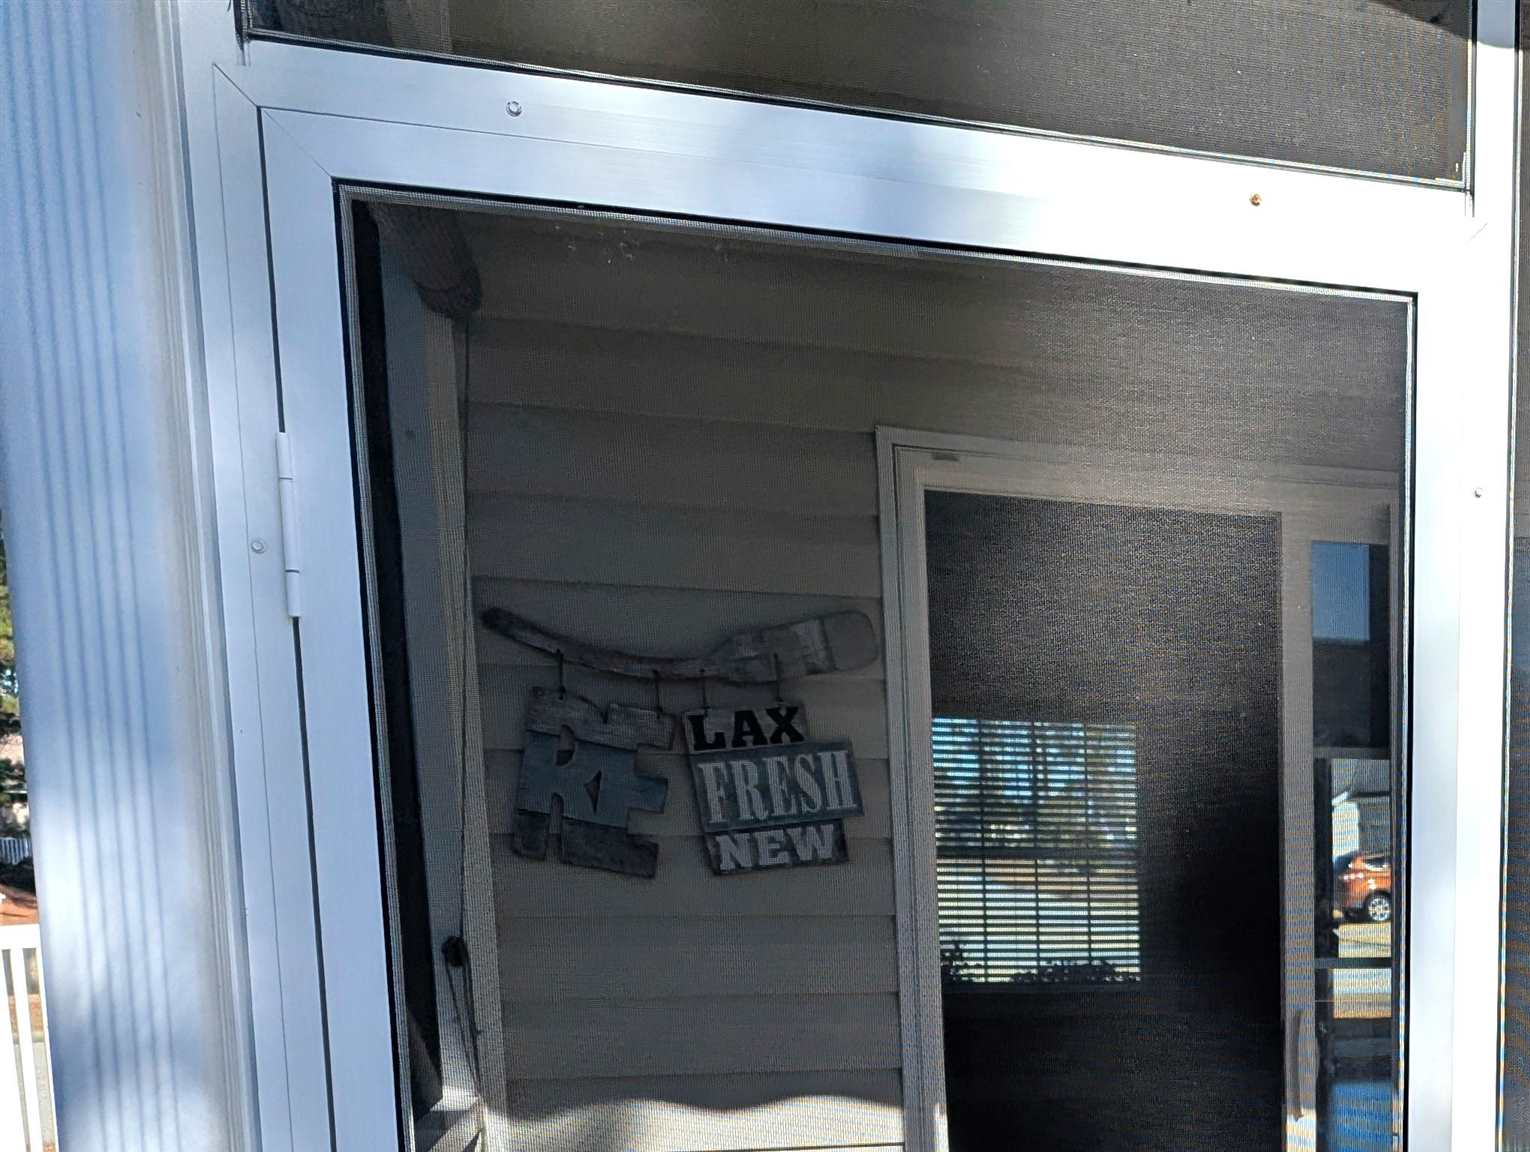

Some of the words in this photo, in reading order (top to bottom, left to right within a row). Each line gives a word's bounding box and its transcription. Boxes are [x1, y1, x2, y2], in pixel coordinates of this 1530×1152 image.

[687, 706, 805, 751] LAX
[698, 750, 857, 824] FRESH
[716, 823, 834, 871] NEW
